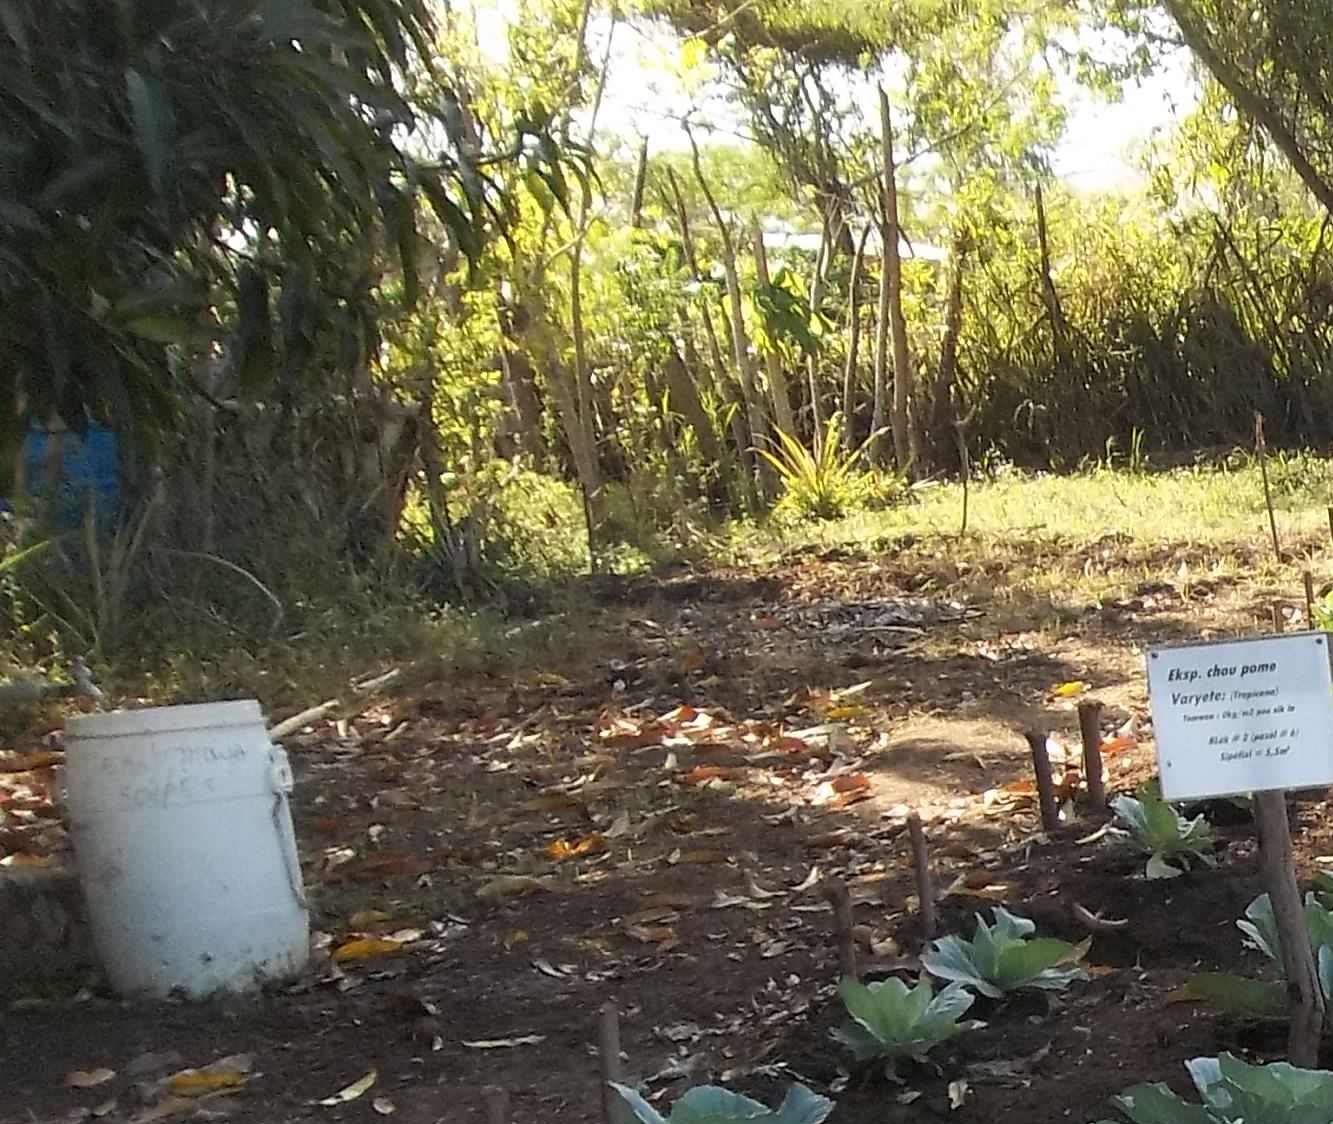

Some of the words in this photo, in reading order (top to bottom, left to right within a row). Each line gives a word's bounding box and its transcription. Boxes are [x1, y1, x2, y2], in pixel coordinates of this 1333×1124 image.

[1168, 668, 1201, 683] Eksp.
[1207, 664, 1236, 678] chou
[1240, 662, 1277, 677] pome
[1172, 690, 1225, 706] Varyete:
